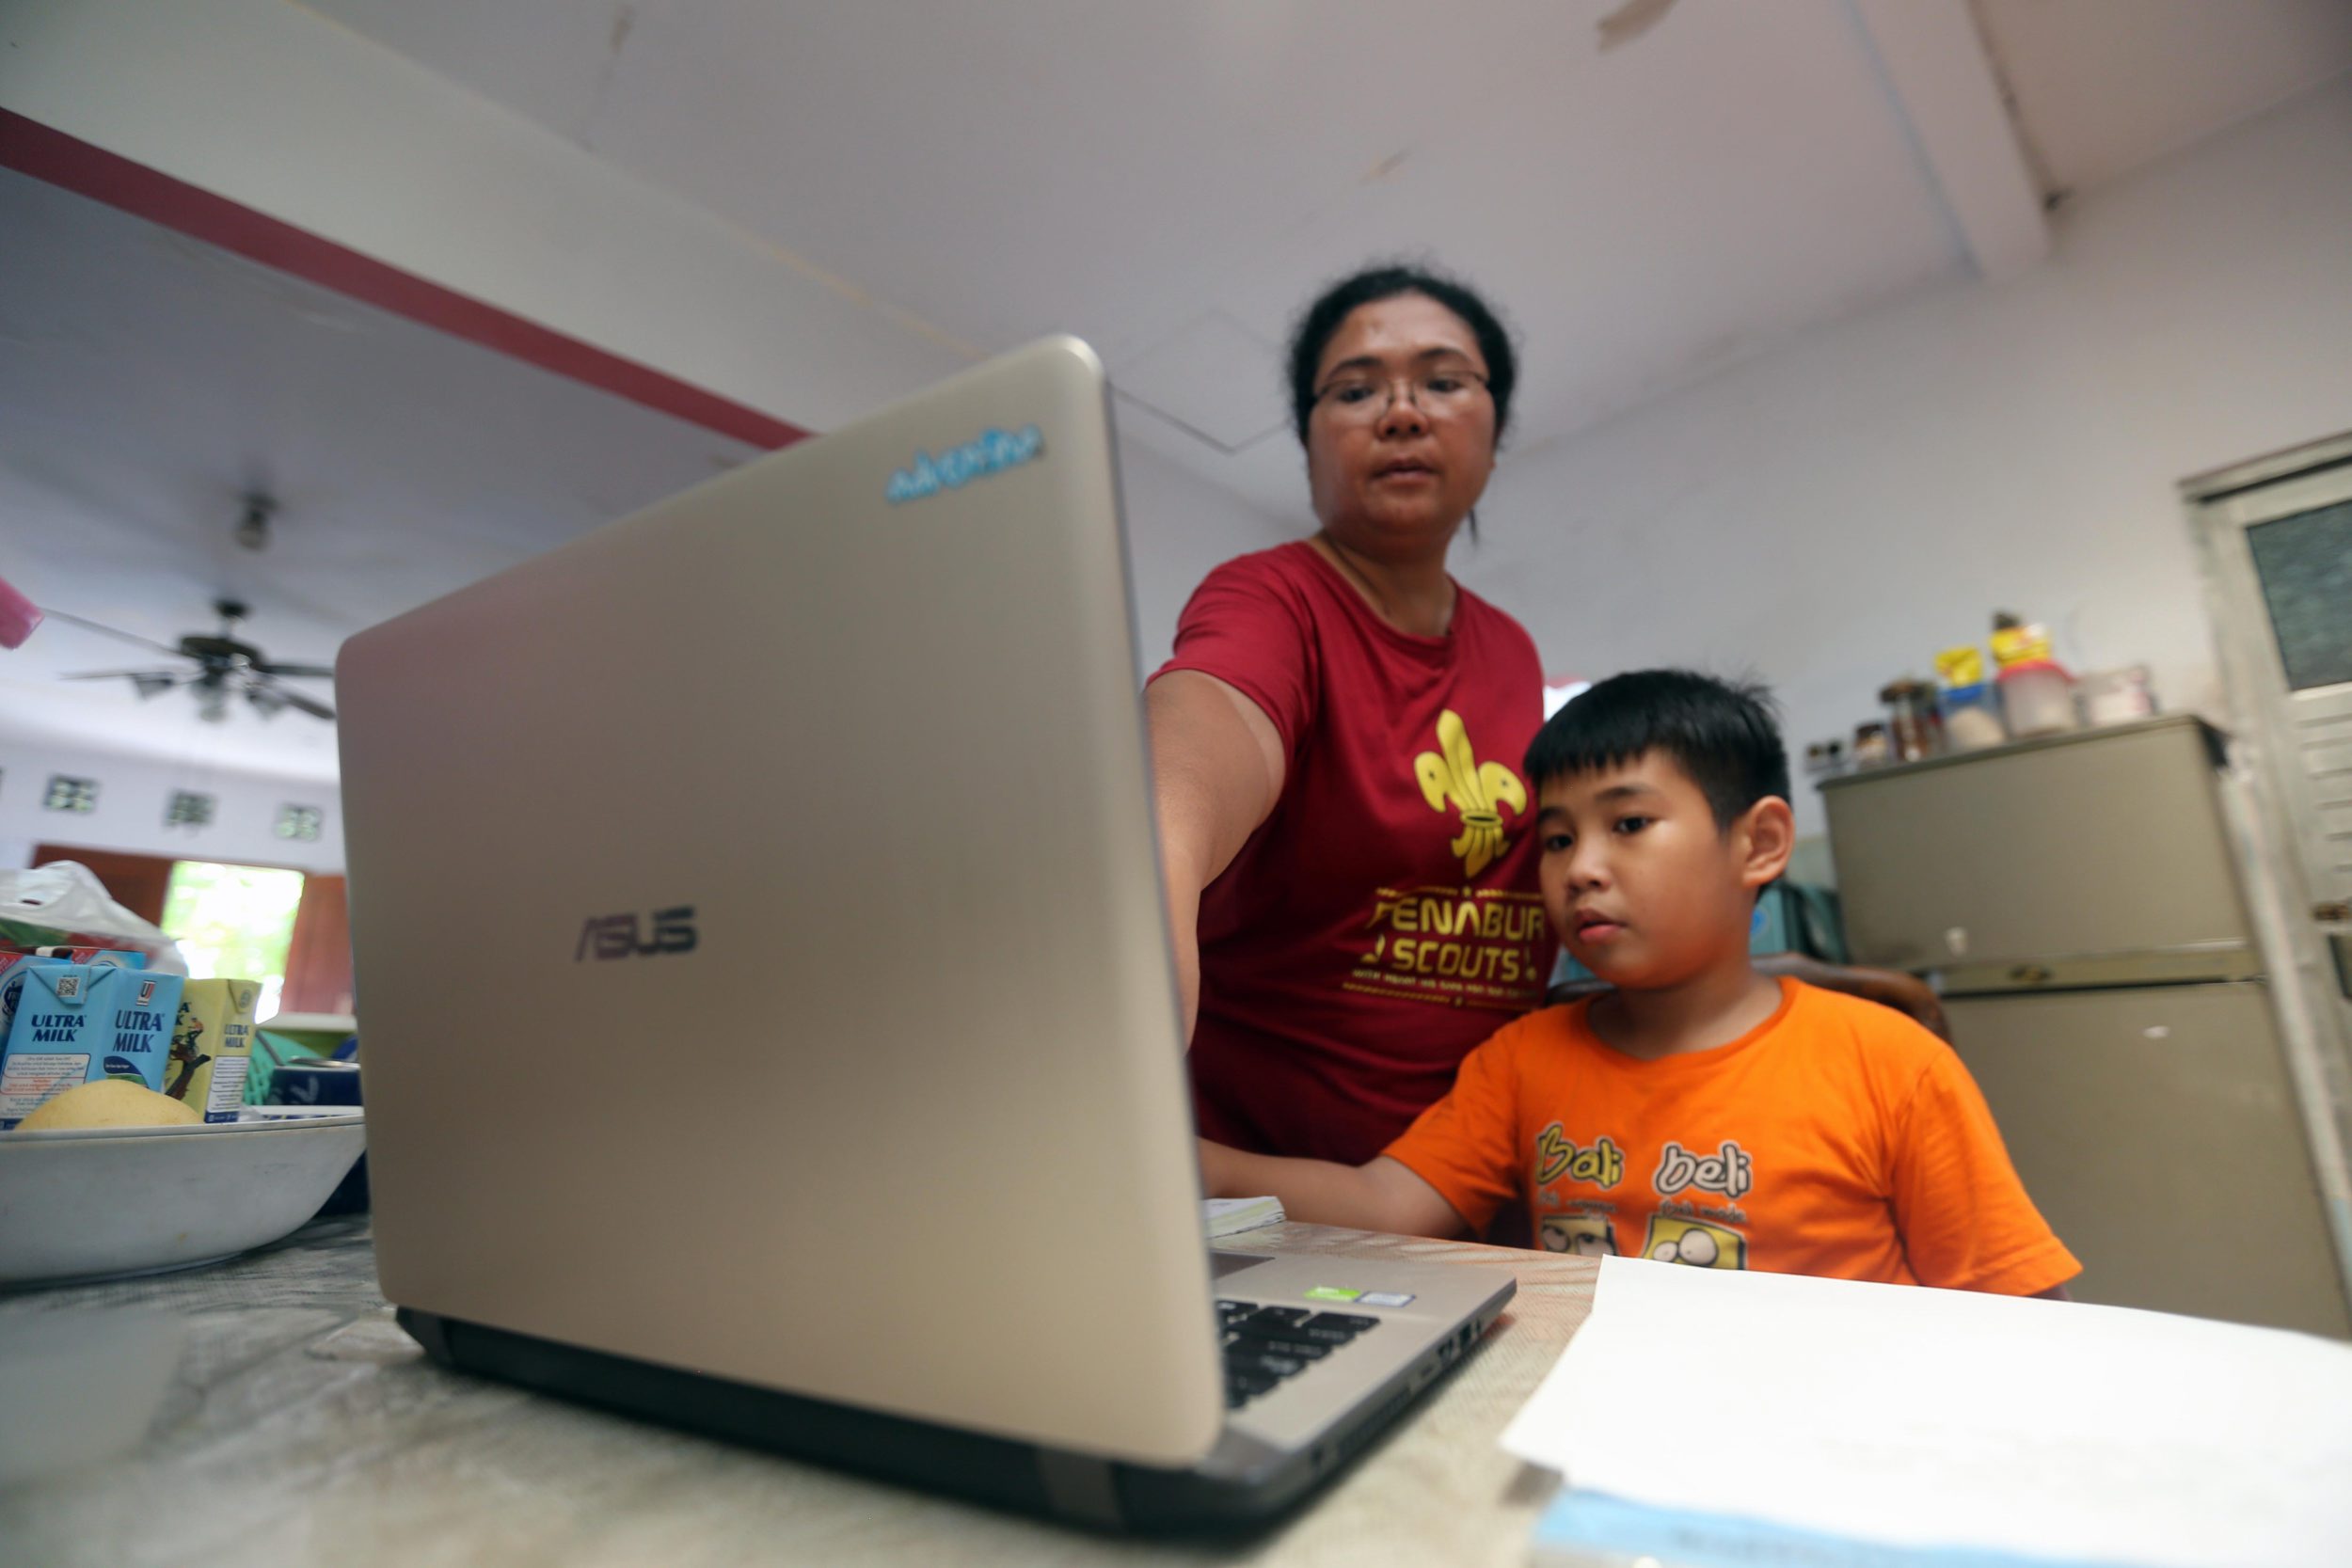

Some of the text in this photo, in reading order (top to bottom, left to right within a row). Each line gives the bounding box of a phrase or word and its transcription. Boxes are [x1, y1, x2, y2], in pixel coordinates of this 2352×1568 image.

[574, 906, 697, 962] ASUS
[1391, 938, 1520, 982] SCOUTS
[31, 1014, 85, 1028] ULTRA
[115, 1009, 163, 1032] ULTRA
[224, 1023, 249, 1036] ULTRA
[32, 1028, 77, 1042] MILK
[112, 1032, 154, 1053] MILK
[225, 1037, 246, 1048] MILK
[1535, 1123, 1753, 1199] Bali beli
